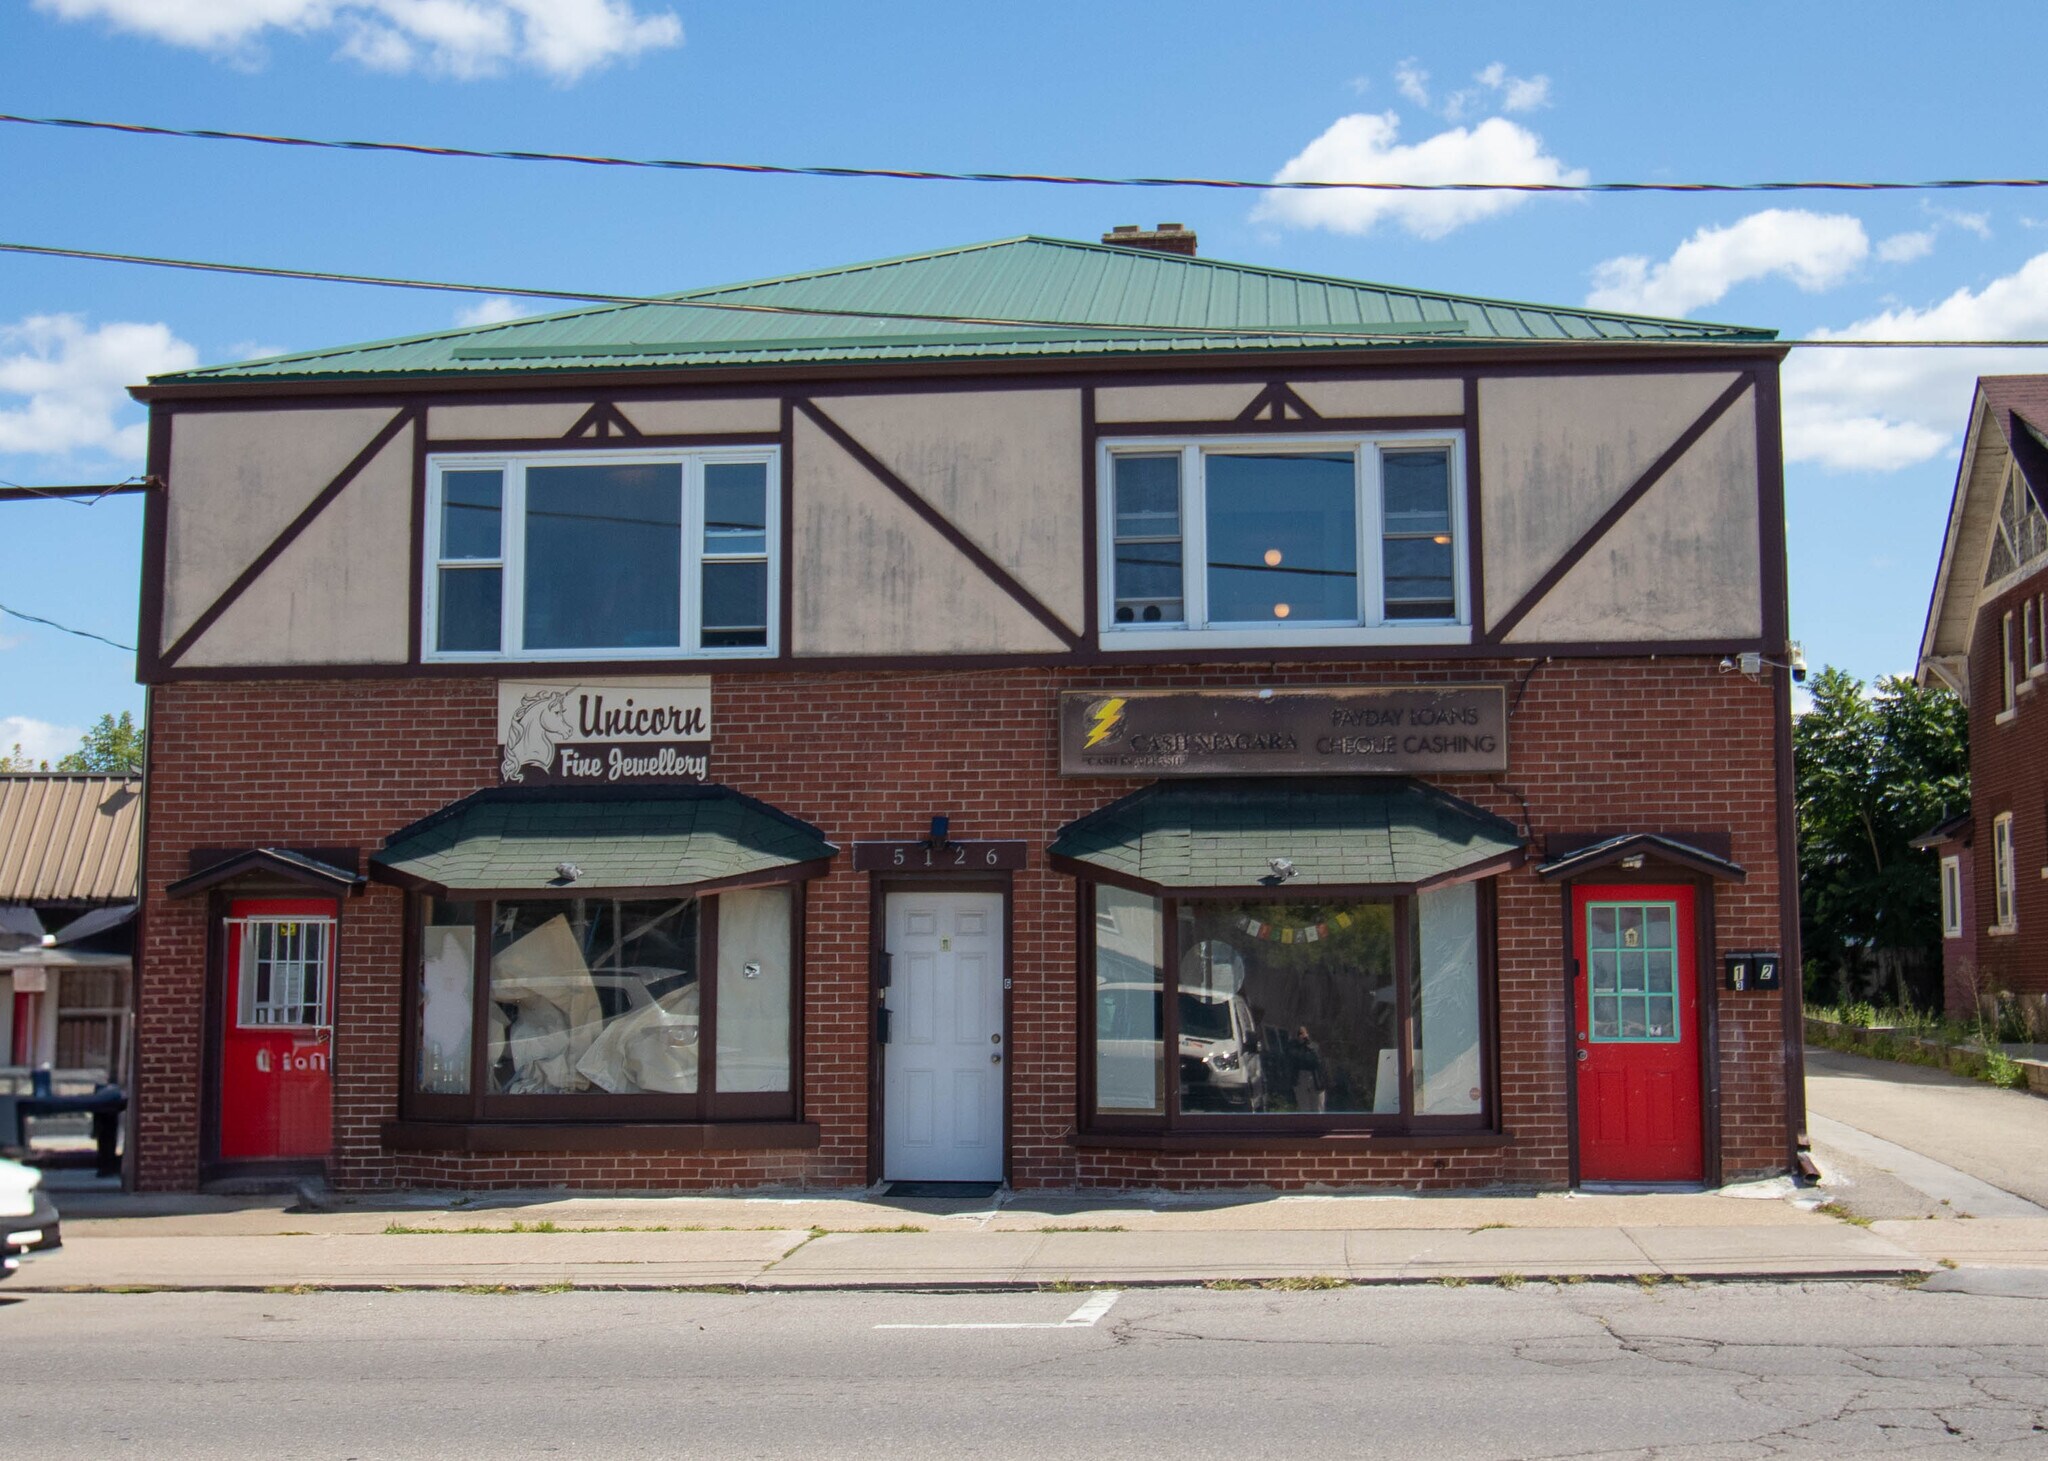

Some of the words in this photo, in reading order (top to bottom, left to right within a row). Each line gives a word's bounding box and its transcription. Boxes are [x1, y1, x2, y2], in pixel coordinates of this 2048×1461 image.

[579, 695, 706, 737] Unicorn
[1331, 708, 1404, 727] PAYDAY
[1410, 707, 1479, 726] LOANS
[1403, 736, 1496, 754] CASHING
[560, 748, 603, 777] Fine
[608, 747, 707, 781] Jewellery
[893, 848, 998, 867] 5126
[1761, 965, 1772, 979] 2
